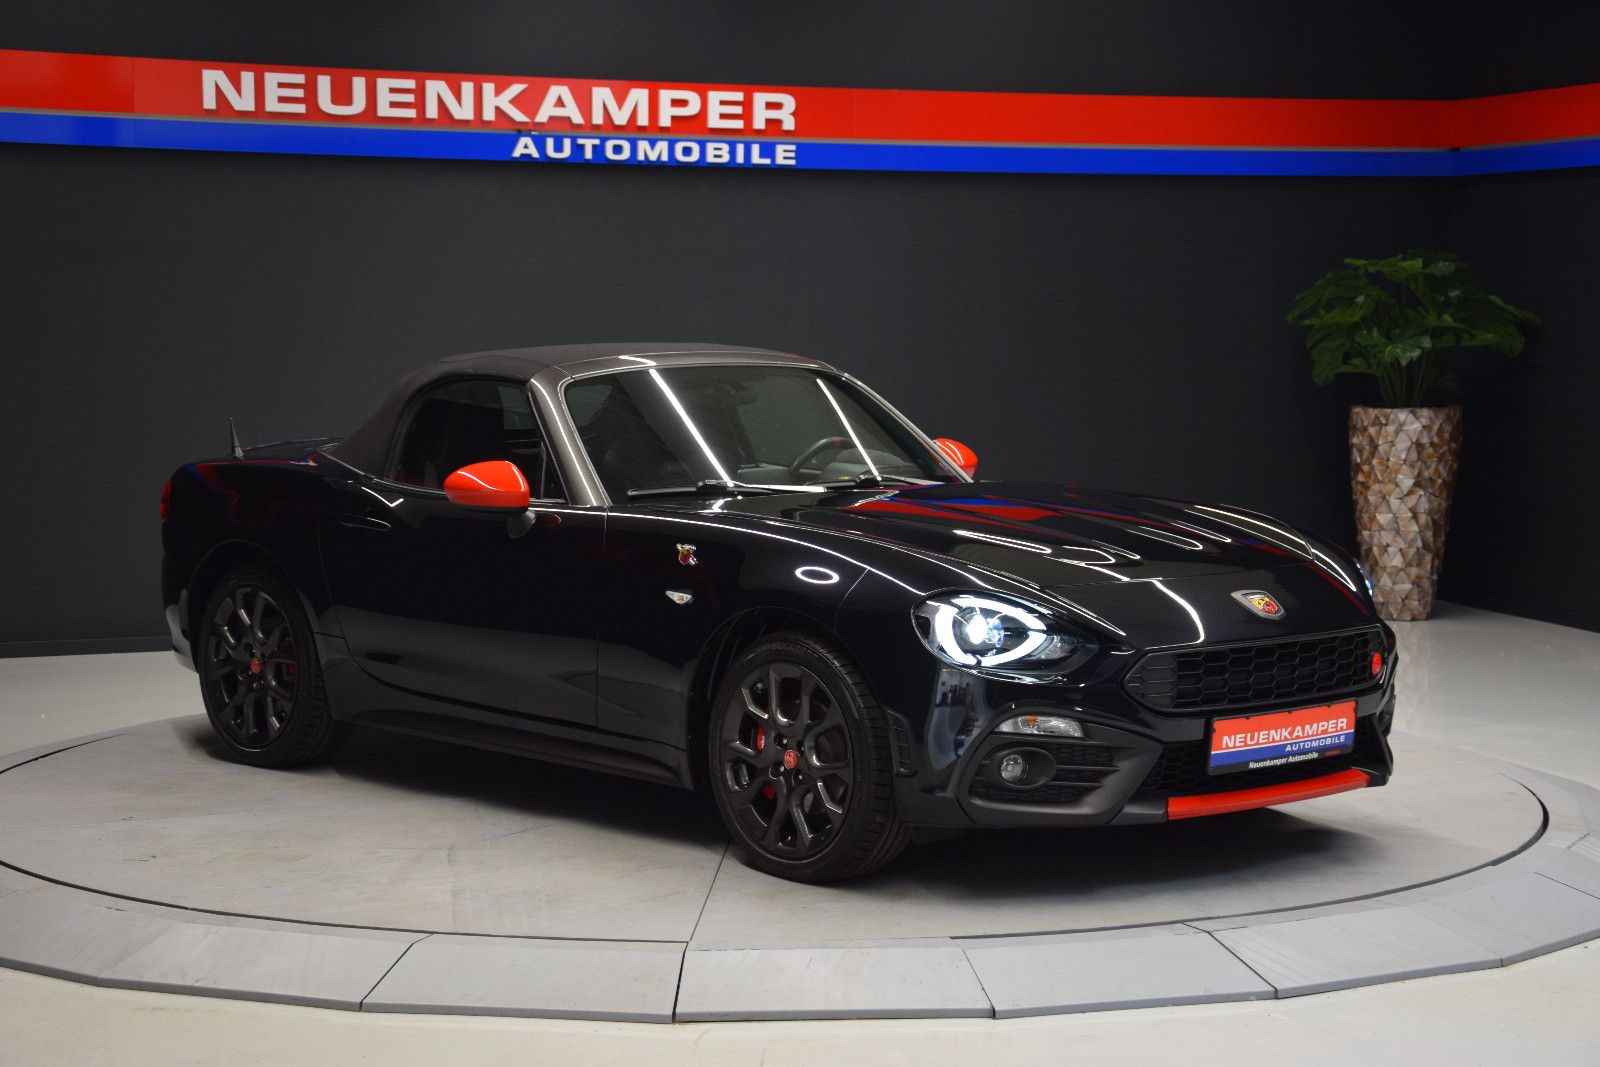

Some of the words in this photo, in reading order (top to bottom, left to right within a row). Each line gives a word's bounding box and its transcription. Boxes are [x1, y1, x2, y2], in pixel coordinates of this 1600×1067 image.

[201, 69, 796, 132] NEUENKAMPER
[512, 136, 797, 165] AUTOMOBILE
[1222, 718, 1348, 748] NEUENKAMPER
[1285, 735, 1346, 752] AUTOMOBILE
[1248, 757, 1288, 769] Neuenkamper
[1288, 752, 1319, 763] Automobile
